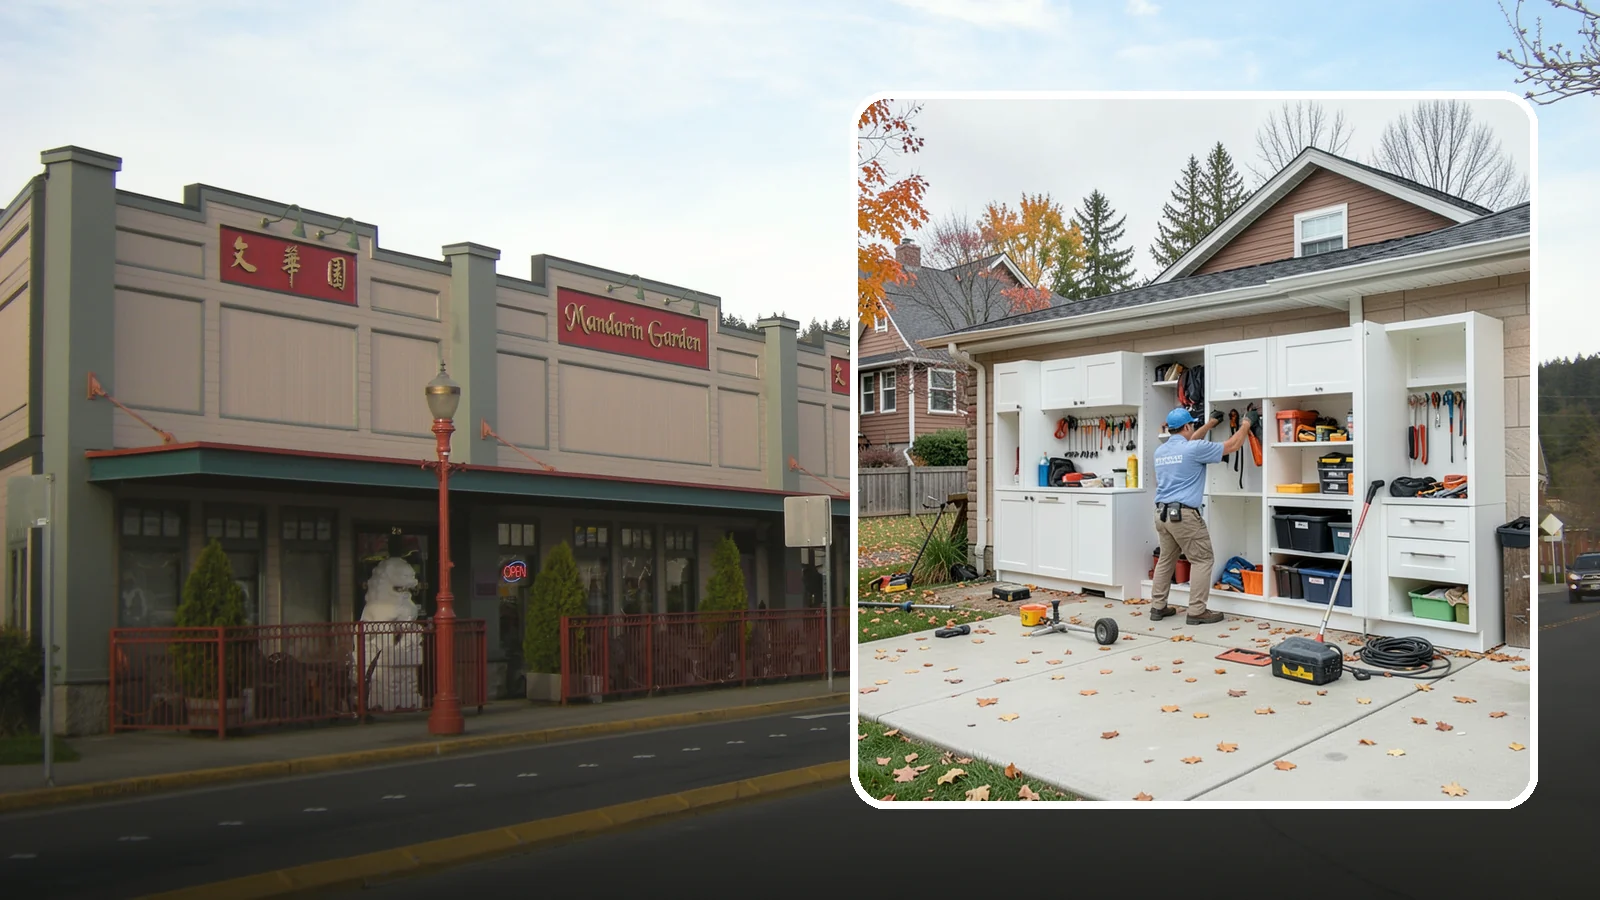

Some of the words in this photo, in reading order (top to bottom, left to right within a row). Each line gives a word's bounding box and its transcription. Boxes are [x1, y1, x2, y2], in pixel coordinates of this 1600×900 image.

[230, 235, 346, 291] 文華園
[564, 302, 644, 341] Mandarin
[647, 320, 701, 352] Garden
[503, 565, 527, 578] OPEN
